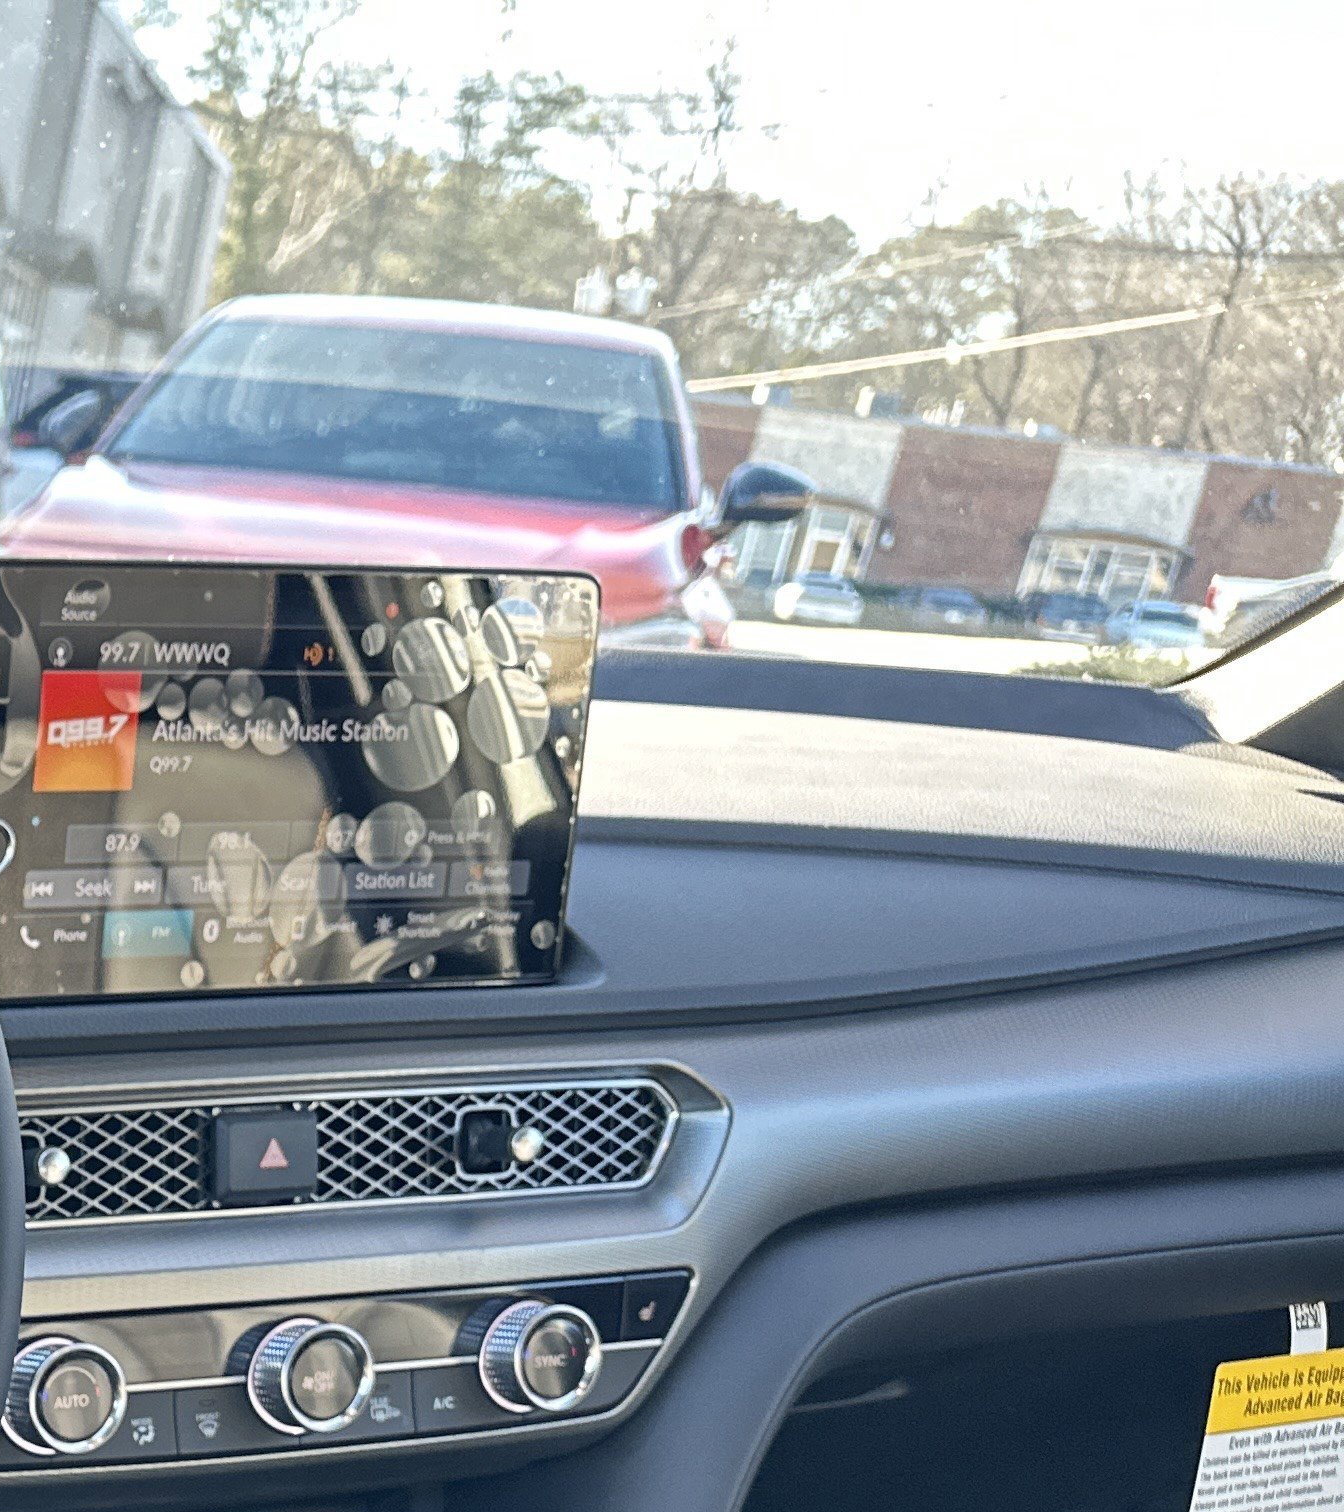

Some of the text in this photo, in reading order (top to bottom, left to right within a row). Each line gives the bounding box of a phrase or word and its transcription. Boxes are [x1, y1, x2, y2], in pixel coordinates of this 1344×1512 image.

[61, 607, 98, 622] Source
[99, 641, 142, 663] 99.7
[153, 642, 231, 665] WWWQ
[152, 719, 409, 743] Atlanta's Hit Music Station
[149, 756, 193, 774] Q99.7
[105, 833, 141, 852] 87.9
[74, 877, 113, 898] Seek
[355, 871, 435, 889] Station List
[534, 1354, 566, 1367] SYNC
[1217, 1377, 1242, 1398] This
[1246, 1371, 1290, 1393] Vehicle
[53, 1393, 90, 1409] AUTO
[432, 1397, 456, 1410] A/C
[1243, 1392, 1303, 1417] Advanced
[1304, 1389, 1324, 1409] Air
